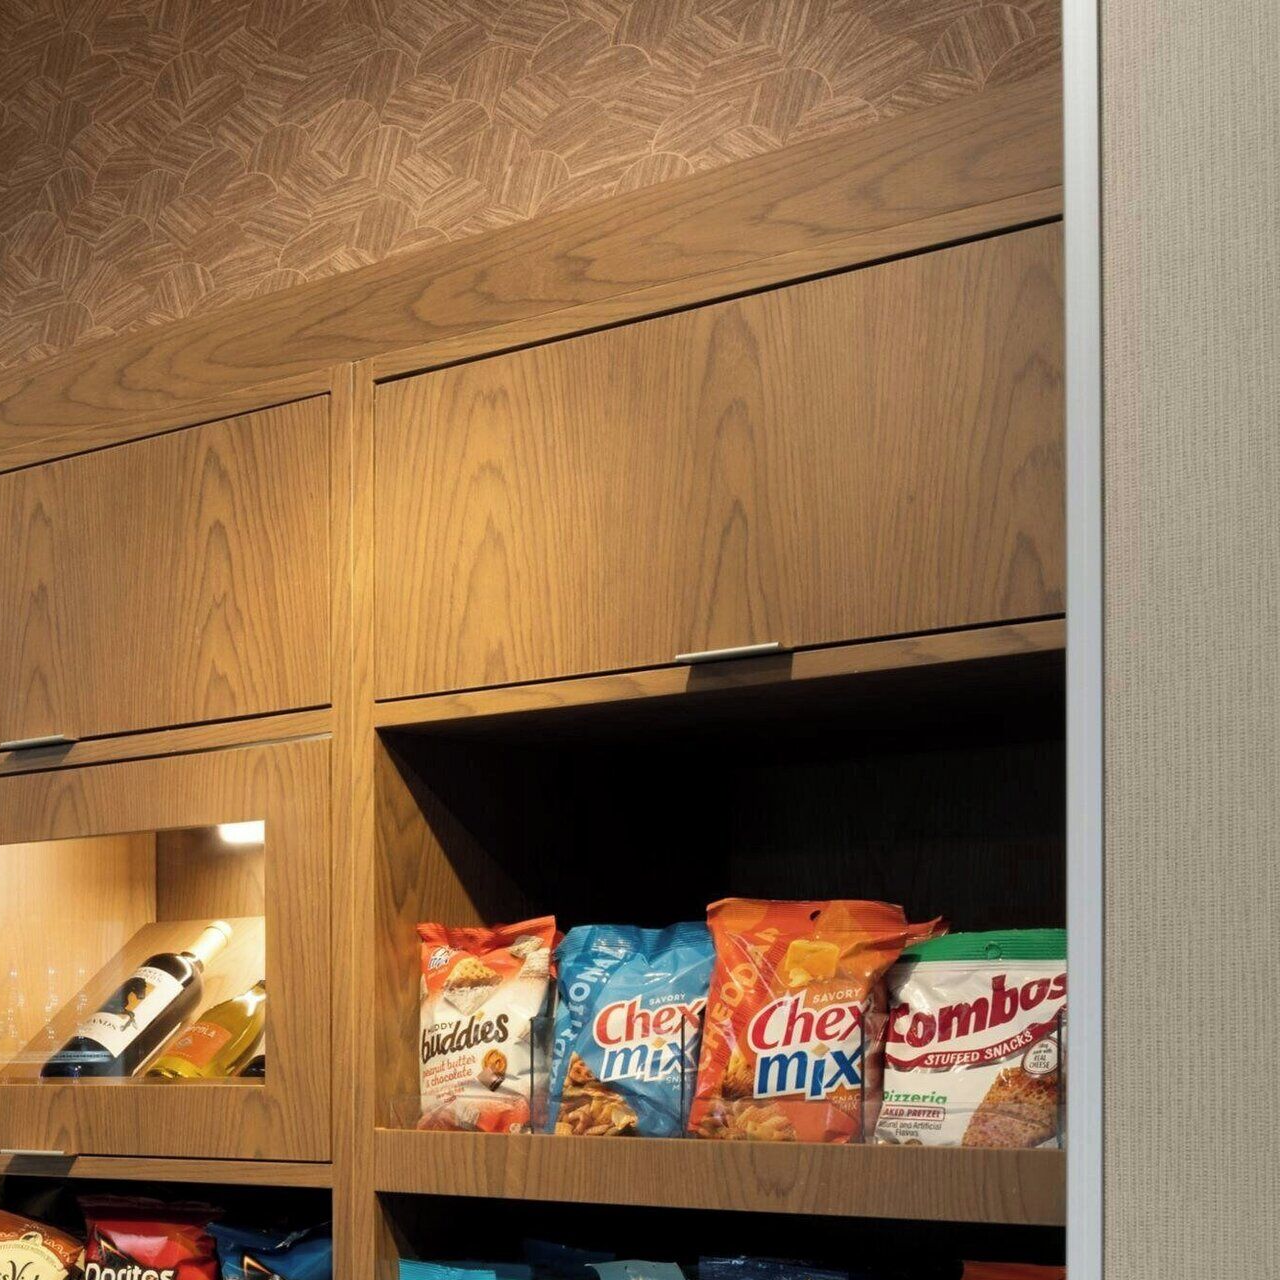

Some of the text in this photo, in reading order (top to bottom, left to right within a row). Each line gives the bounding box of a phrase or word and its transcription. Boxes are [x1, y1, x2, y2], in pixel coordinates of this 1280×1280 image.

[649, 994, 686, 1006] SAVORY
[812, 988, 863, 1004] SAVORY
[421, 1013, 509, 1065] buddies
[594, 998, 706, 1046] Chex
[750, 995, 863, 1051] Chex
[602, 1041, 697, 1080] mix
[923, 1030, 1034, 1066] STUFFED SNACKS
[756, 1050, 863, 1098] mix
